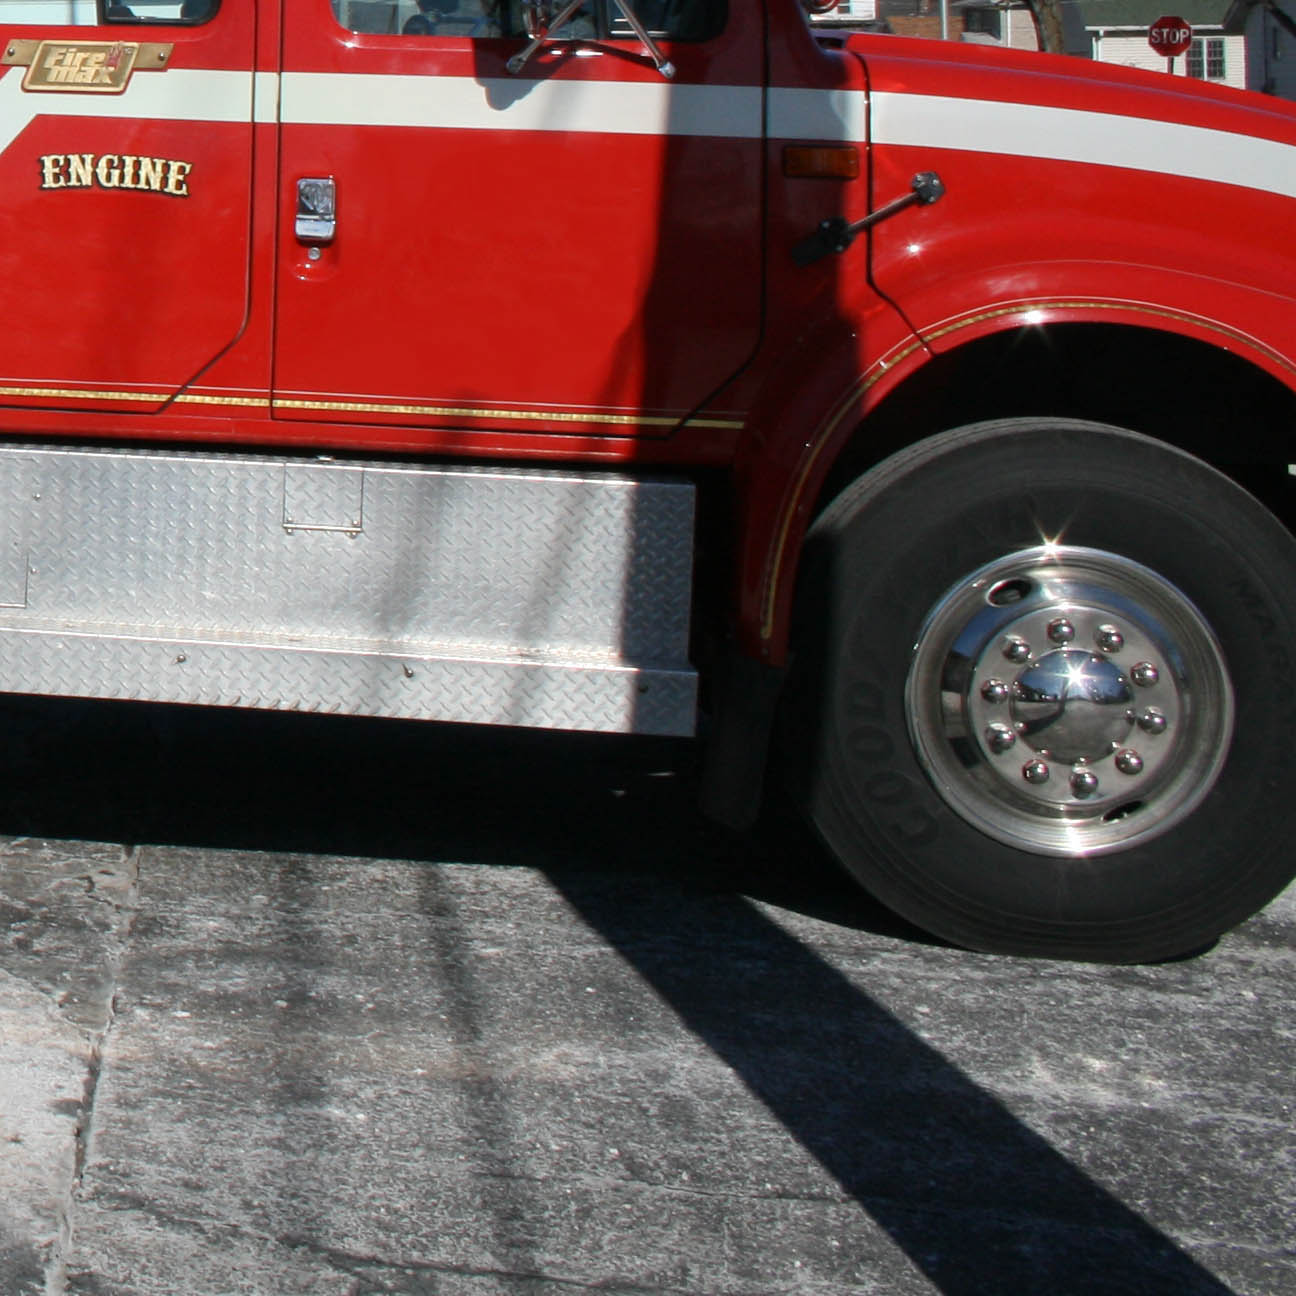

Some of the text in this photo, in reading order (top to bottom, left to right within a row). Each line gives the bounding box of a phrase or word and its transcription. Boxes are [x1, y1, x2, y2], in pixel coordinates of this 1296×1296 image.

[1151, 28, 1190, 44] STOP
[42, 48, 107, 68] Fire
[39, 154, 192, 197] ENGINE
